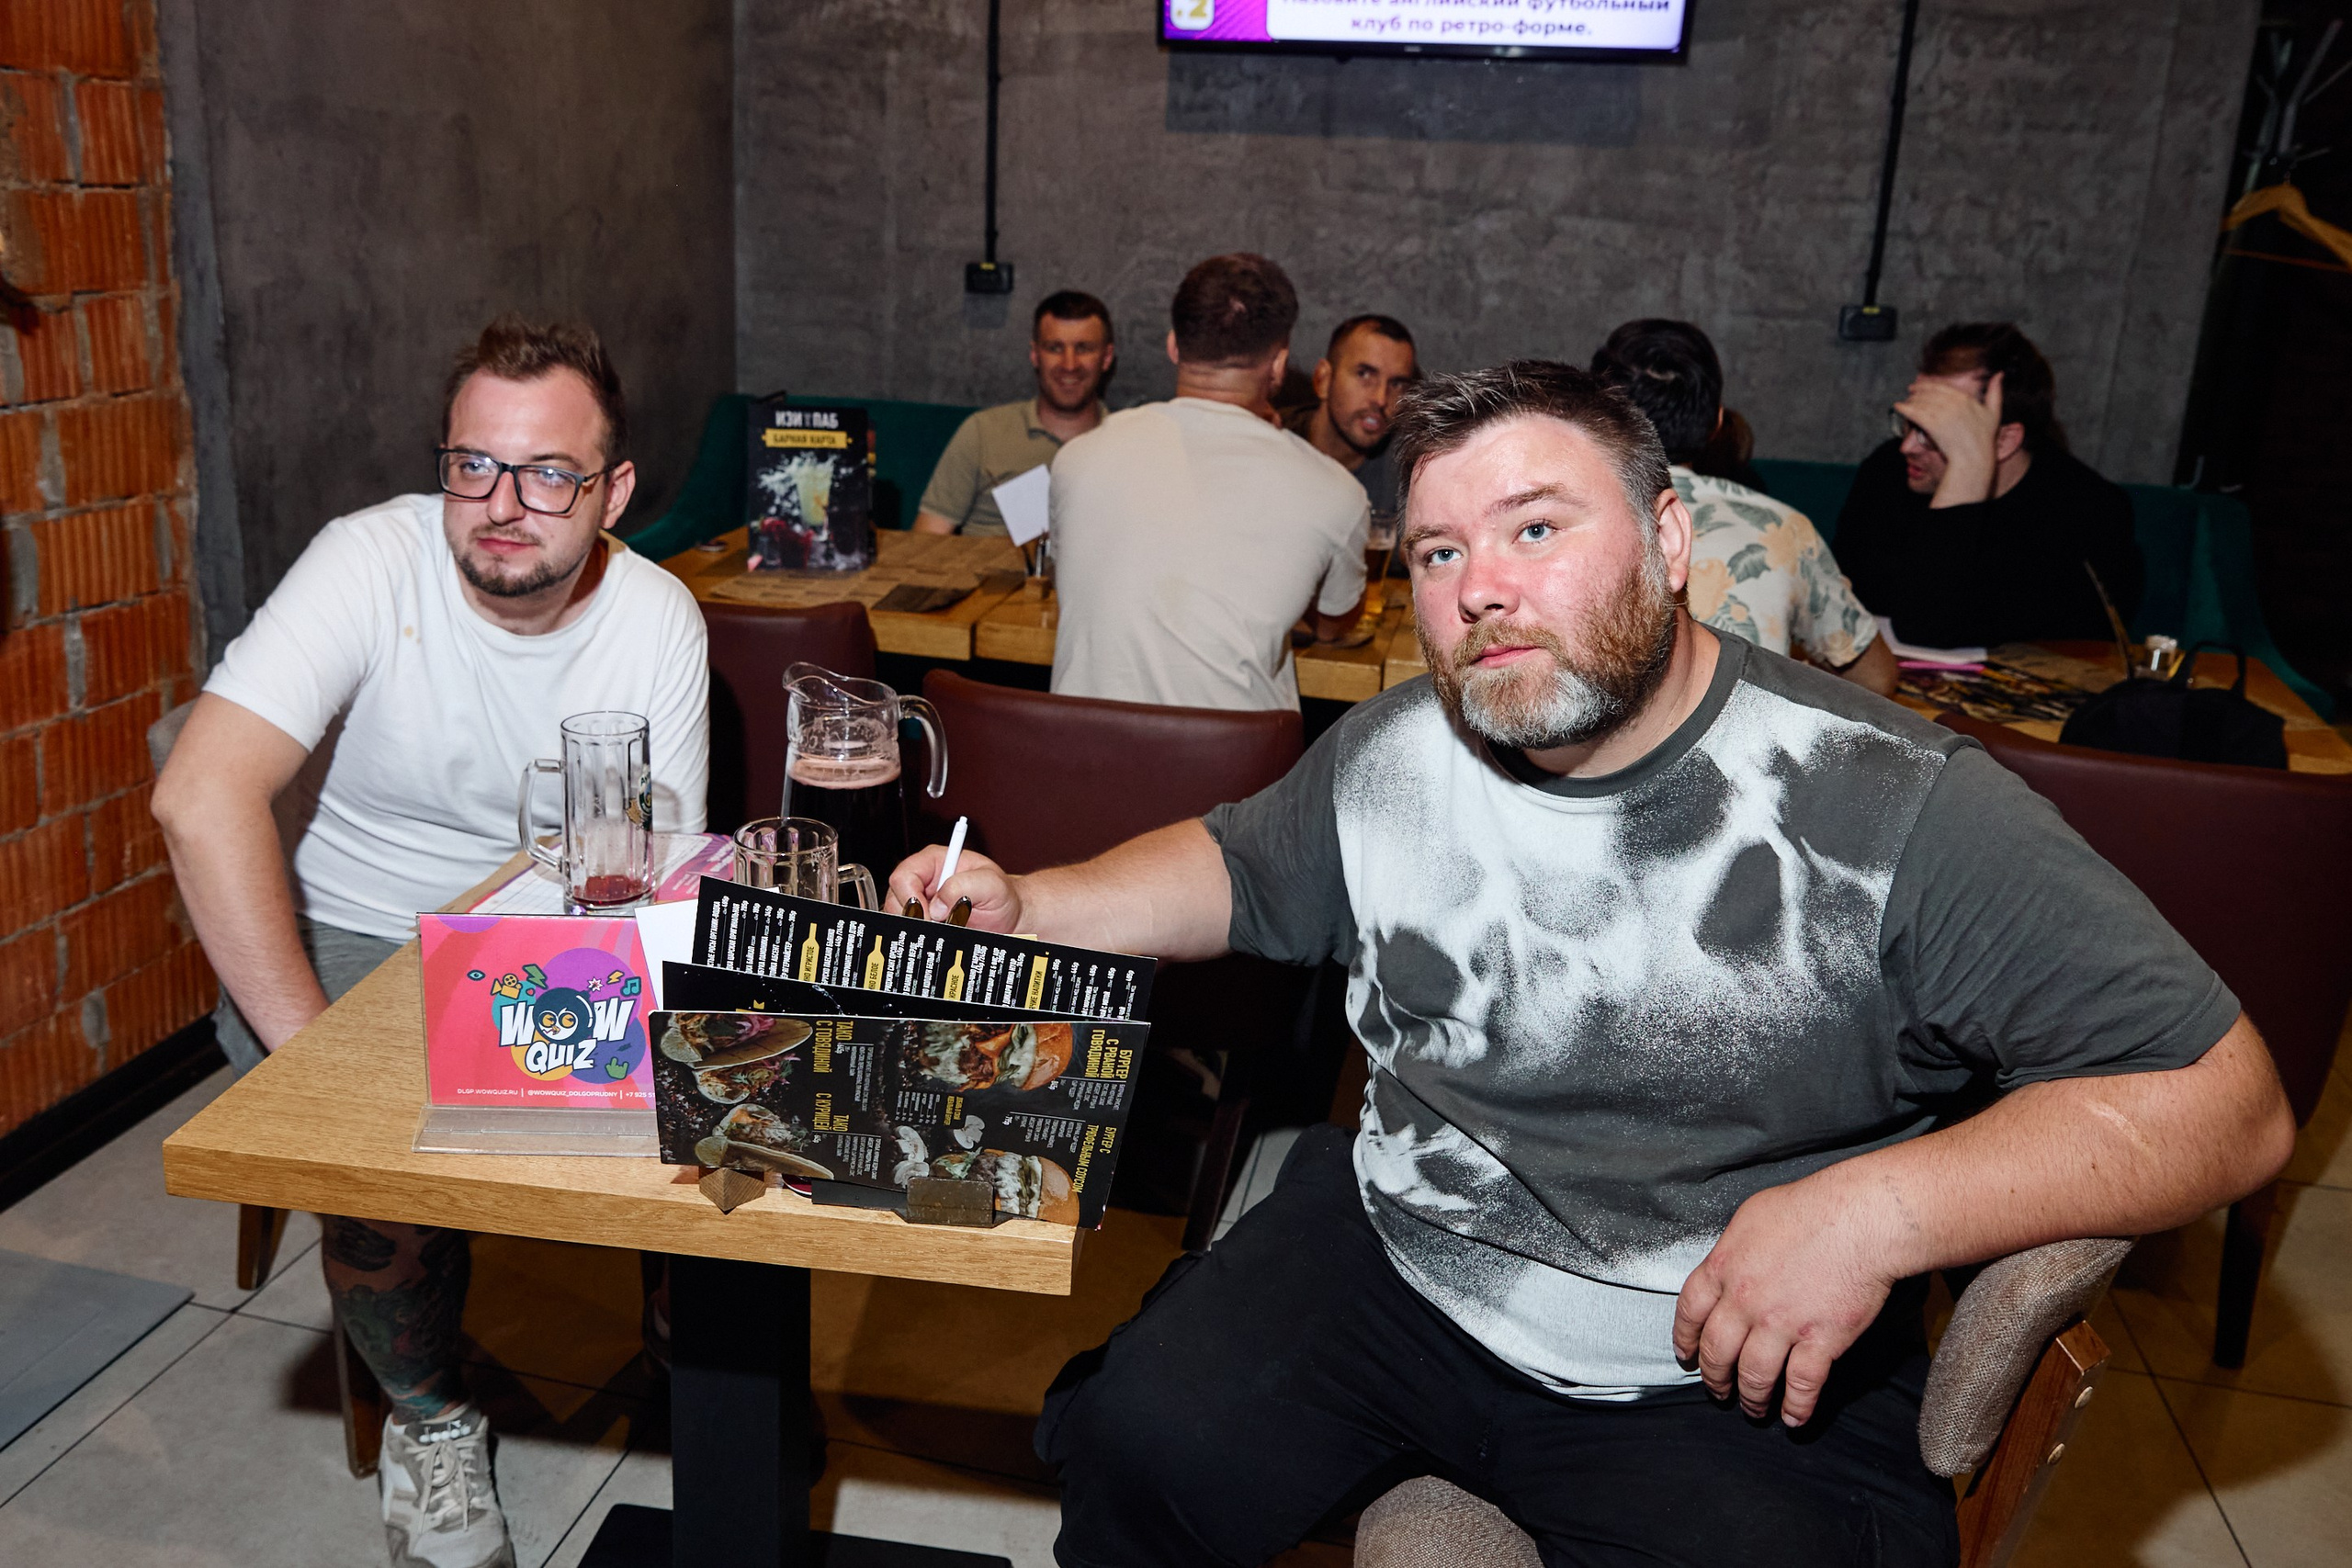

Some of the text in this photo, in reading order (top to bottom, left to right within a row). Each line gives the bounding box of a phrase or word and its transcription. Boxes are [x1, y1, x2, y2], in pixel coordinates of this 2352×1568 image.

[1351, 16, 1593, 37] клуб по ретро-форме.
[811, 412, 840, 430] ПАБ
[773, 434, 837, 445] БАРНАЯ КАРТА
[746, 946, 754, 964] БАЙКАЛ
[771, 943, 779, 962] АБСЕНТ
[805, 946, 814, 972] ИГРИСТОЕ
[870, 963, 878, 979] БЕЛОЕ
[1009, 958, 1018, 971] НУАР
[949, 975, 959, 998] КРАСНОЕ
[1032, 971, 1042, 995] НАПИТКИ
[836, 1021, 854, 1041] ТАКО
[525, 1038, 599, 1076] QUIZ
[813, 1028, 832, 1073] ГОВЯДИНОЙ
[1085, 1029, 1105, 1077] ГОВЯДИНОЙ
[1101, 1046, 1117, 1078] РВАНОЙ
[1115, 1050, 1133, 1079] БУРГЕР
[457, 1088, 519, 1096] DLGP.WOWQUIZ.RU
[527, 1089, 618, 1098] @WOWQUIZ_DOLGOPRUDNY
[813, 1100, 831, 1130] КУРИЦЕЙ
[831, 1115, 849, 1132] ТАКО
[1102, 1127, 1116, 1147] БУРГЕР
[1071, 1125, 1098, 1192] ТРЮФЕЛЬНЫМ СОУСОМ
